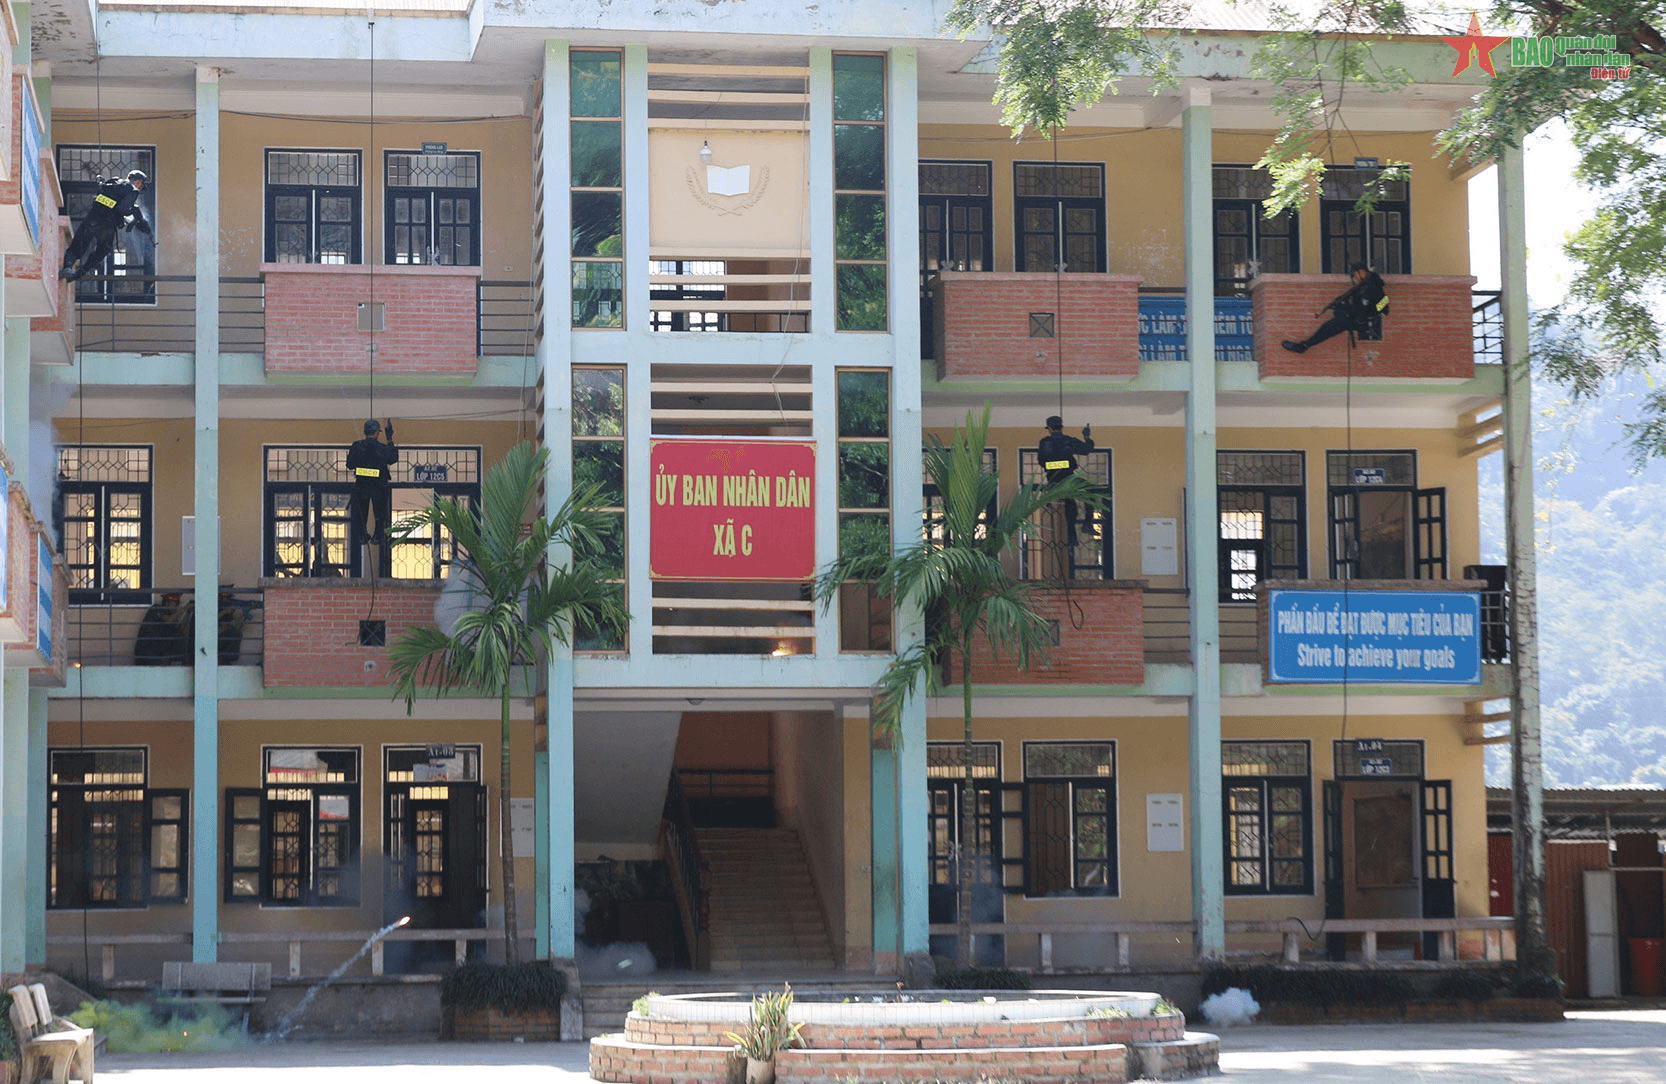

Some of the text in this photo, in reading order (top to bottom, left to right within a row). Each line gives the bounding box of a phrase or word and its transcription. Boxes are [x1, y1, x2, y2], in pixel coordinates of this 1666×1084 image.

[655, 463, 811, 508] ỦY BAN NHÂN DÂN
[713, 518, 753, 556] XÃ C
[1277, 602, 1304, 634] PHẤN
[1297, 643, 1455, 671] Strive to achieve your goals
